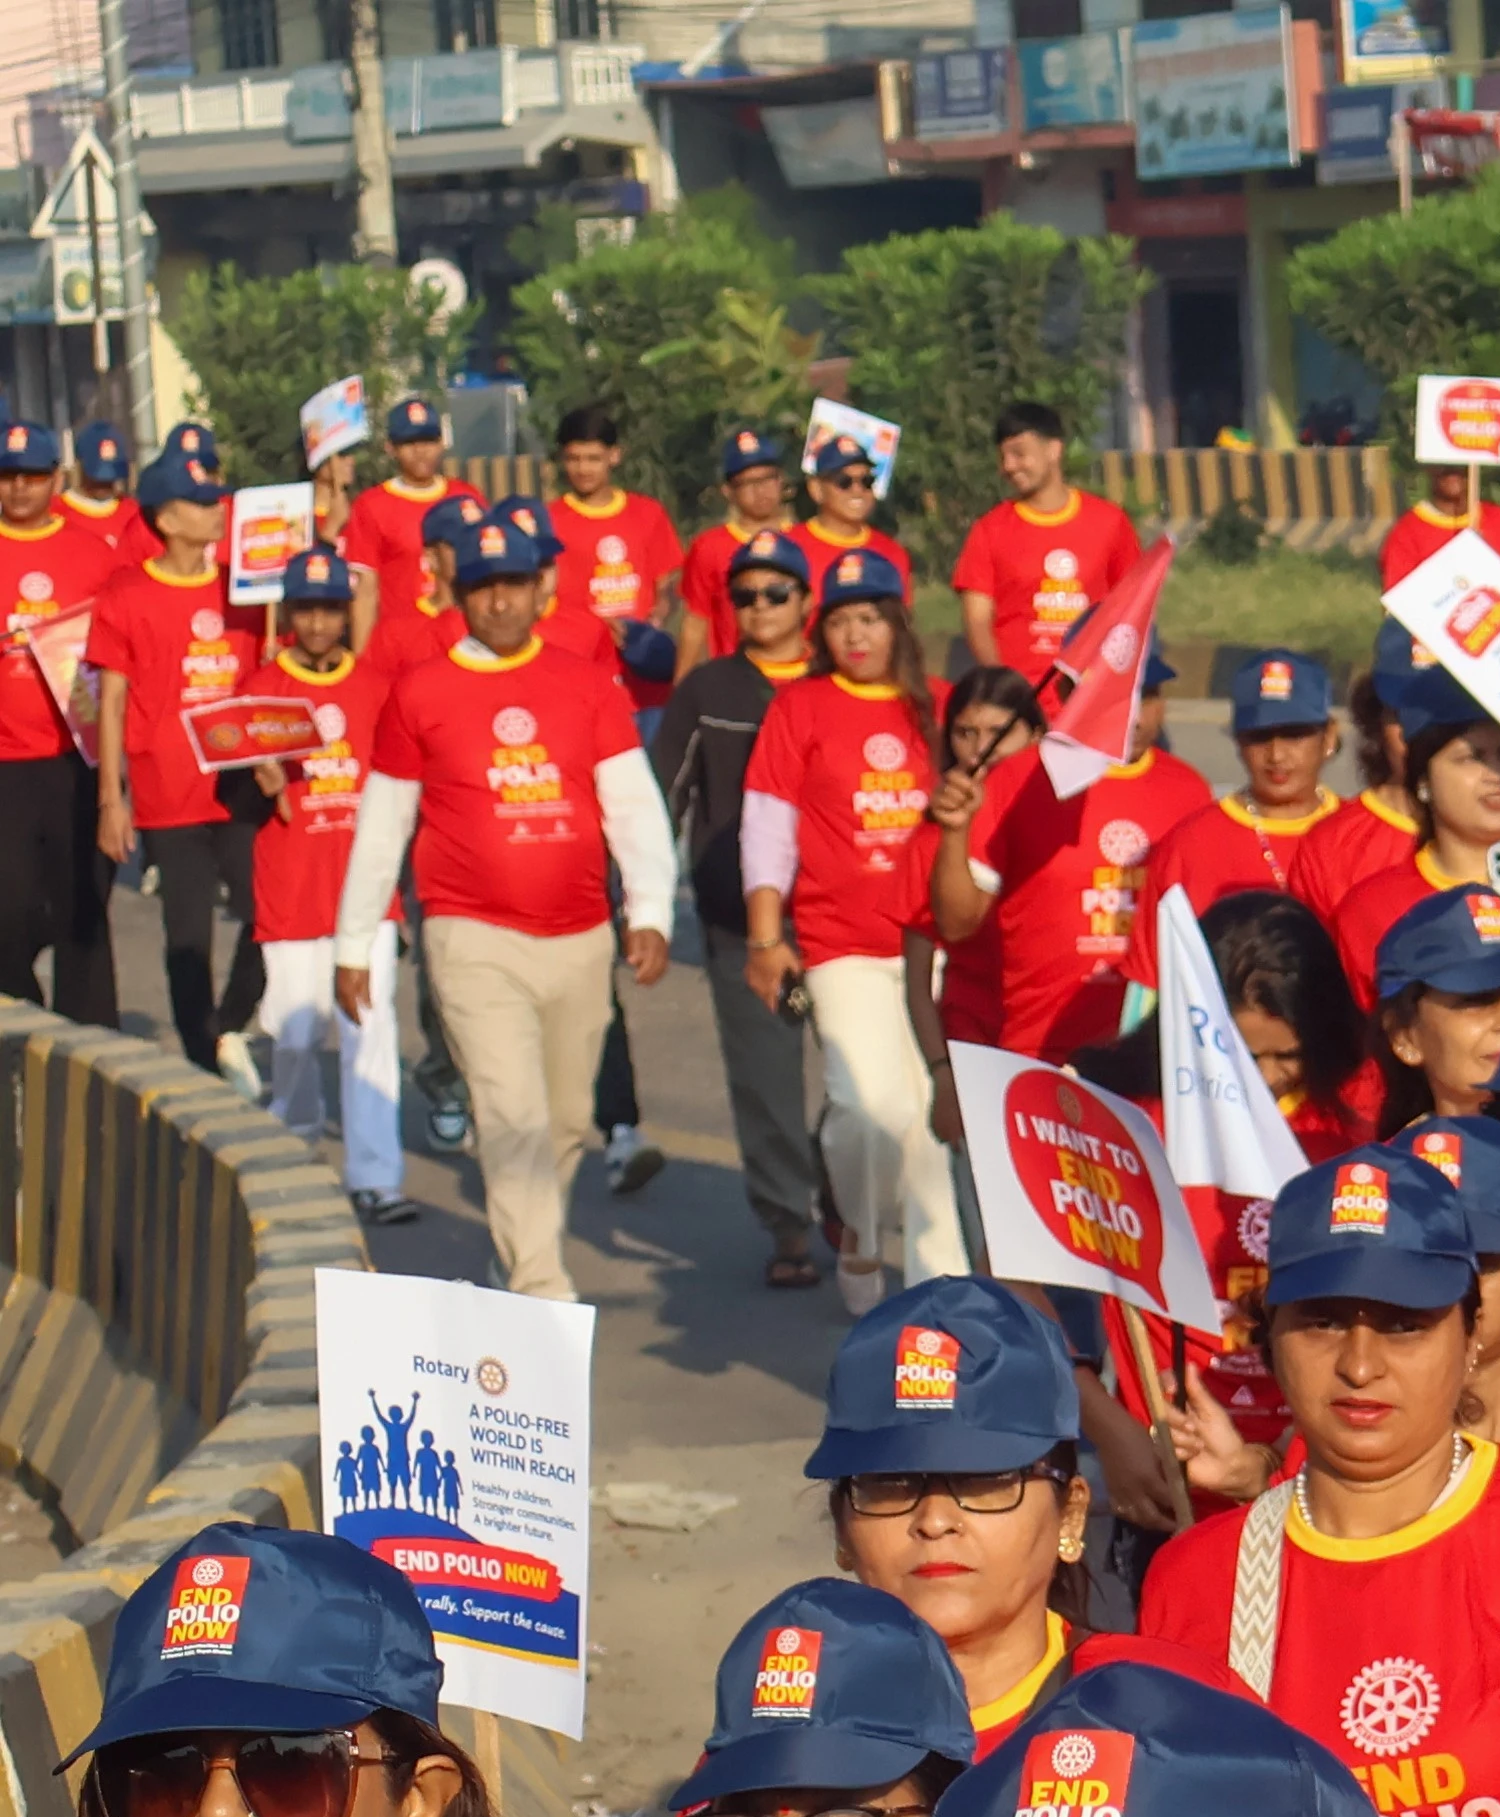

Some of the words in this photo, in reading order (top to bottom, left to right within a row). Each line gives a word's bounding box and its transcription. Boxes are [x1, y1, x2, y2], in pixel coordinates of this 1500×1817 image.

[1014, 1112, 1027, 1137] I
[1031, 1115, 1101, 1160] WANT
[1106, 1142, 1140, 1175] TO
[1058, 1151, 1120, 1200] END
[1050, 1180, 1142, 1240] POLIO
[1068, 1214, 1138, 1268] NOW
[413, 1355, 470, 1383] Rotary
[470, 1404, 480, 1418] A
[484, 1408, 570, 1439] POLIO-FREE
[470, 1425, 526, 1450] WORLD
[530, 1439, 543, 1453] IS
[471, 1447, 525, 1473] WITHIN
[529, 1458, 576, 1485] REACH
[472, 1480, 510, 1500] Healthy
[512, 1488, 553, 1508] children.
[473, 1497, 515, 1517] Stronger
[517, 1505, 577, 1532] communities.
[473, 1514, 481, 1524] A
[483, 1515, 522, 1534] brighter
[523, 1524, 555, 1542] future.
[393, 1549, 440, 1572] END
[443, 1553, 502, 1580] POLIO
[504, 1562, 548, 1588] NOW
[167, 1602, 240, 1628] POLIO
[178, 1588, 232, 1608] END
[171, 1620, 231, 1643] NOW
[425, 1597, 458, 1614] rally.
[462, 1598, 510, 1625] Support
[513, 1613, 534, 1630] the
[535, 1621, 567, 1640] cause.
[1031, 1780, 1110, 1808] END
